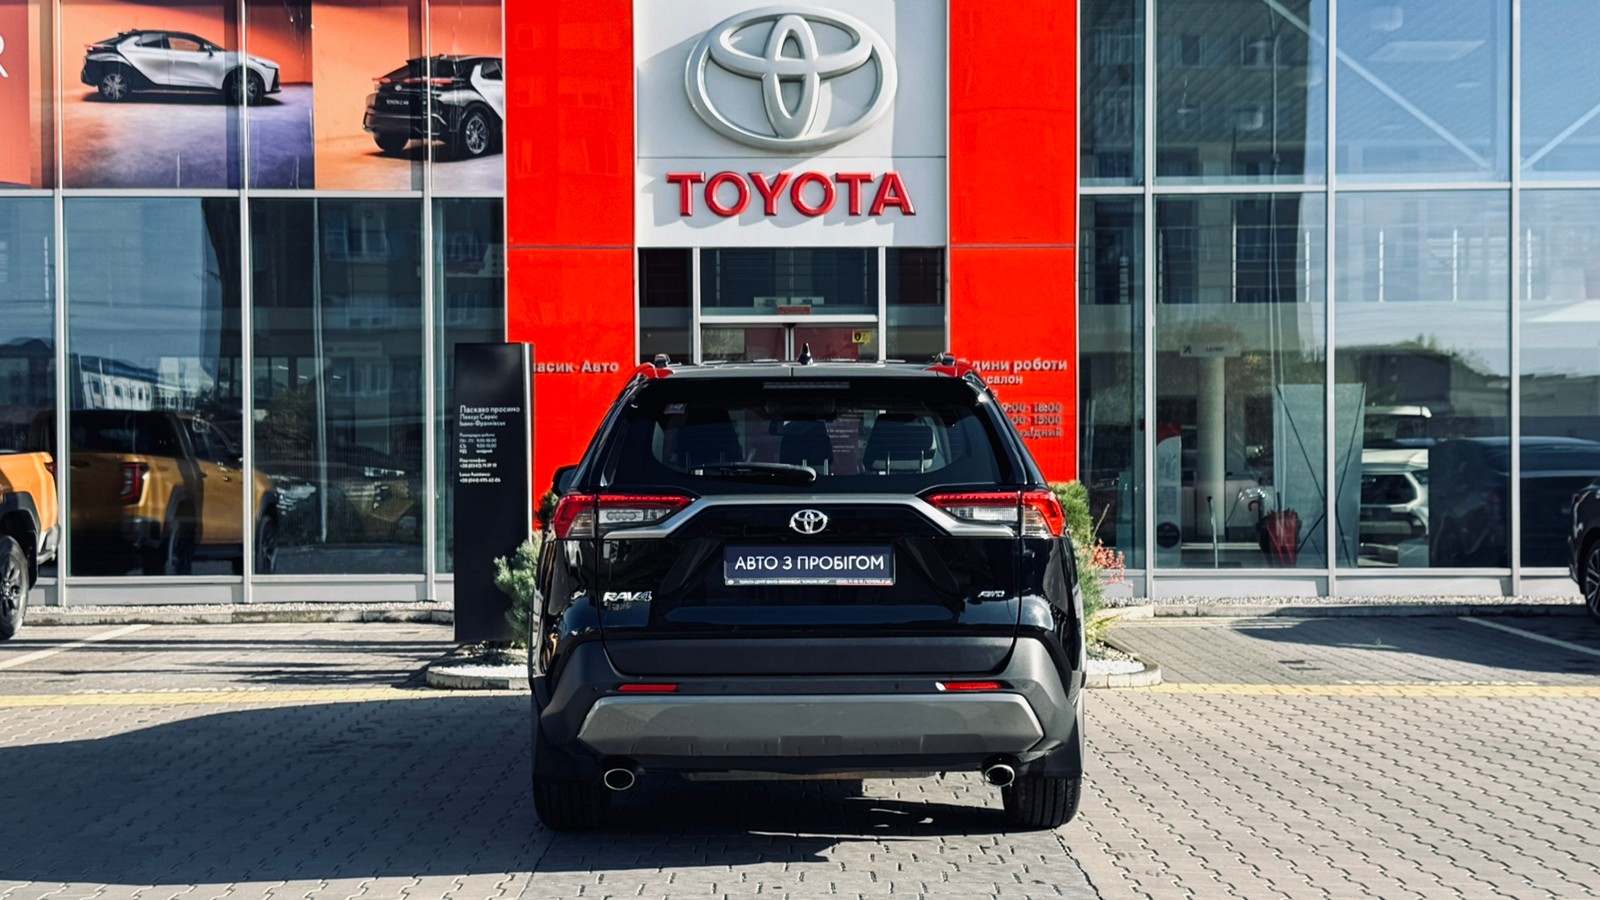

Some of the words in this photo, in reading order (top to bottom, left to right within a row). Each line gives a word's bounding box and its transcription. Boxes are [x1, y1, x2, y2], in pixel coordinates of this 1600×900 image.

[666, 170, 916, 217] TOYOTA
[1014, 357, 1068, 373] роботи
[983, 375, 1023, 384] салон
[735, 556, 778, 570] АВТО
[797, 556, 885, 570] ПРОБІГОМ
[603, 591, 652, 602] RAV4
